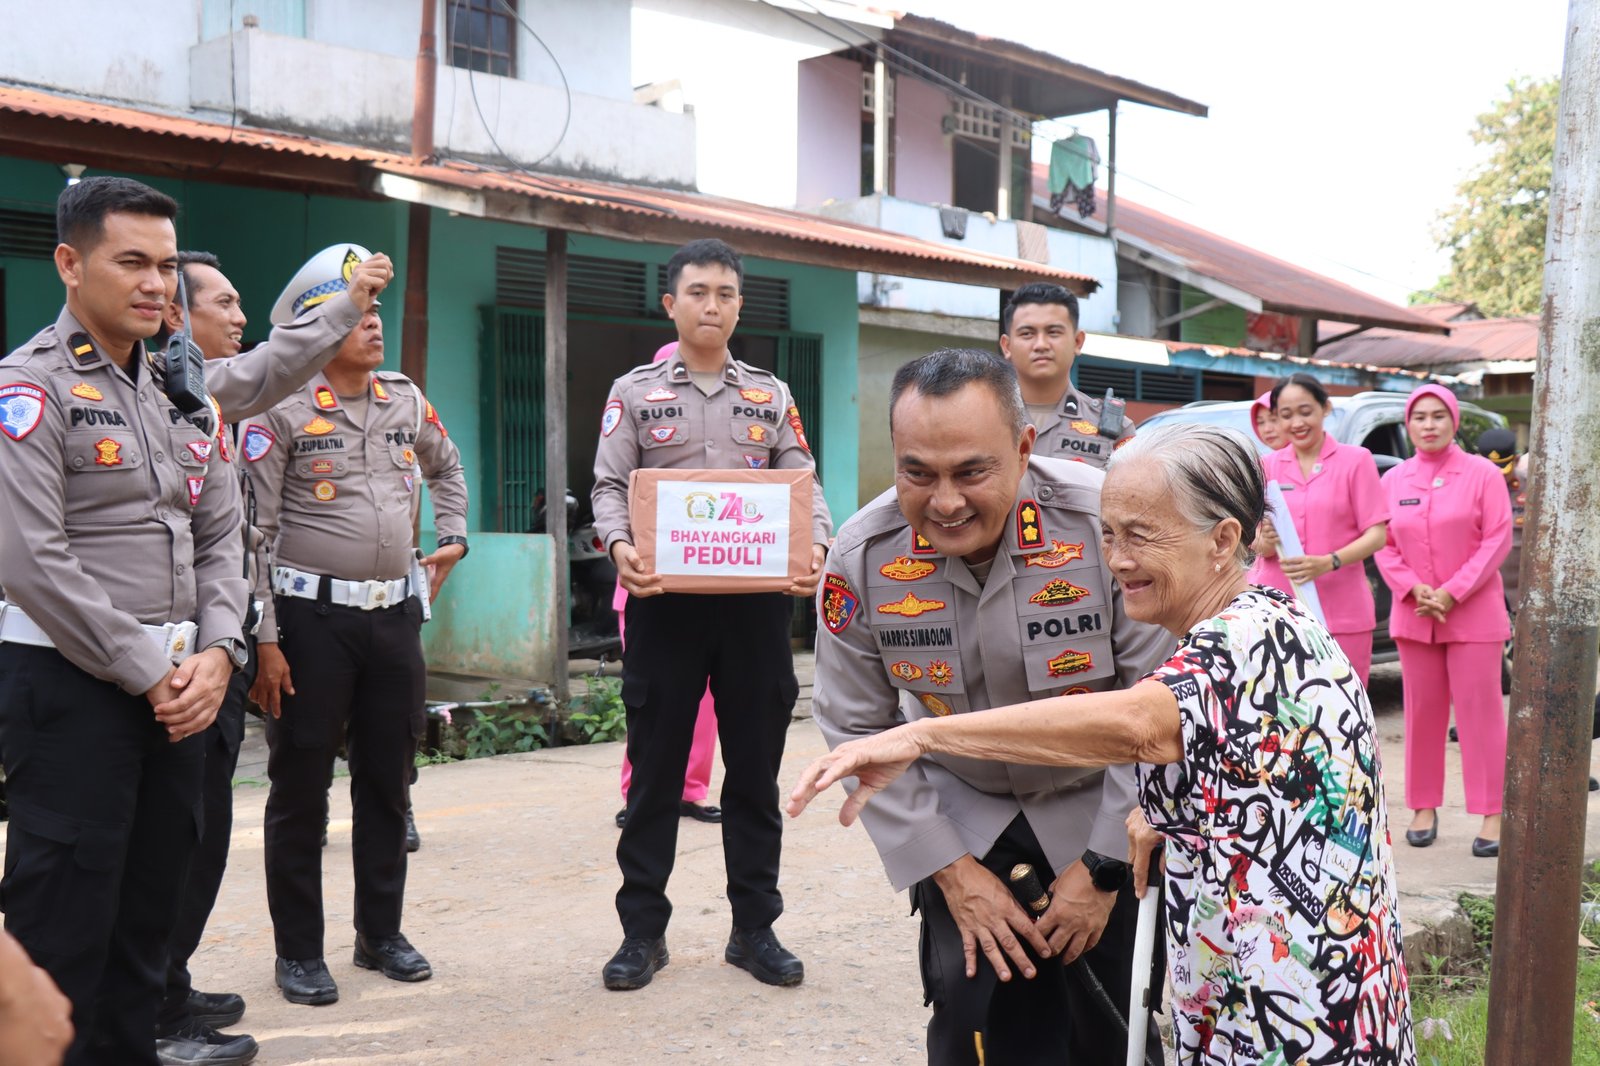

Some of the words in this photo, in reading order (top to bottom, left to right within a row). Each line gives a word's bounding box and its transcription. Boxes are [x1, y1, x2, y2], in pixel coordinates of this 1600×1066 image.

[70, 407, 127, 428] PUTRA
[640, 406, 683, 421] SUGI
[733, 406, 778, 421] POLRI
[385, 432, 415, 445] POLR
[1061, 438, 1101, 454] POLRI
[718, 492, 743, 526] 74
[670, 530, 776, 544] BHAYANGKARI
[683, 546, 762, 565] PEDULI
[828, 577, 850, 590] PROPA
[1027, 613, 1102, 641] POLRI
